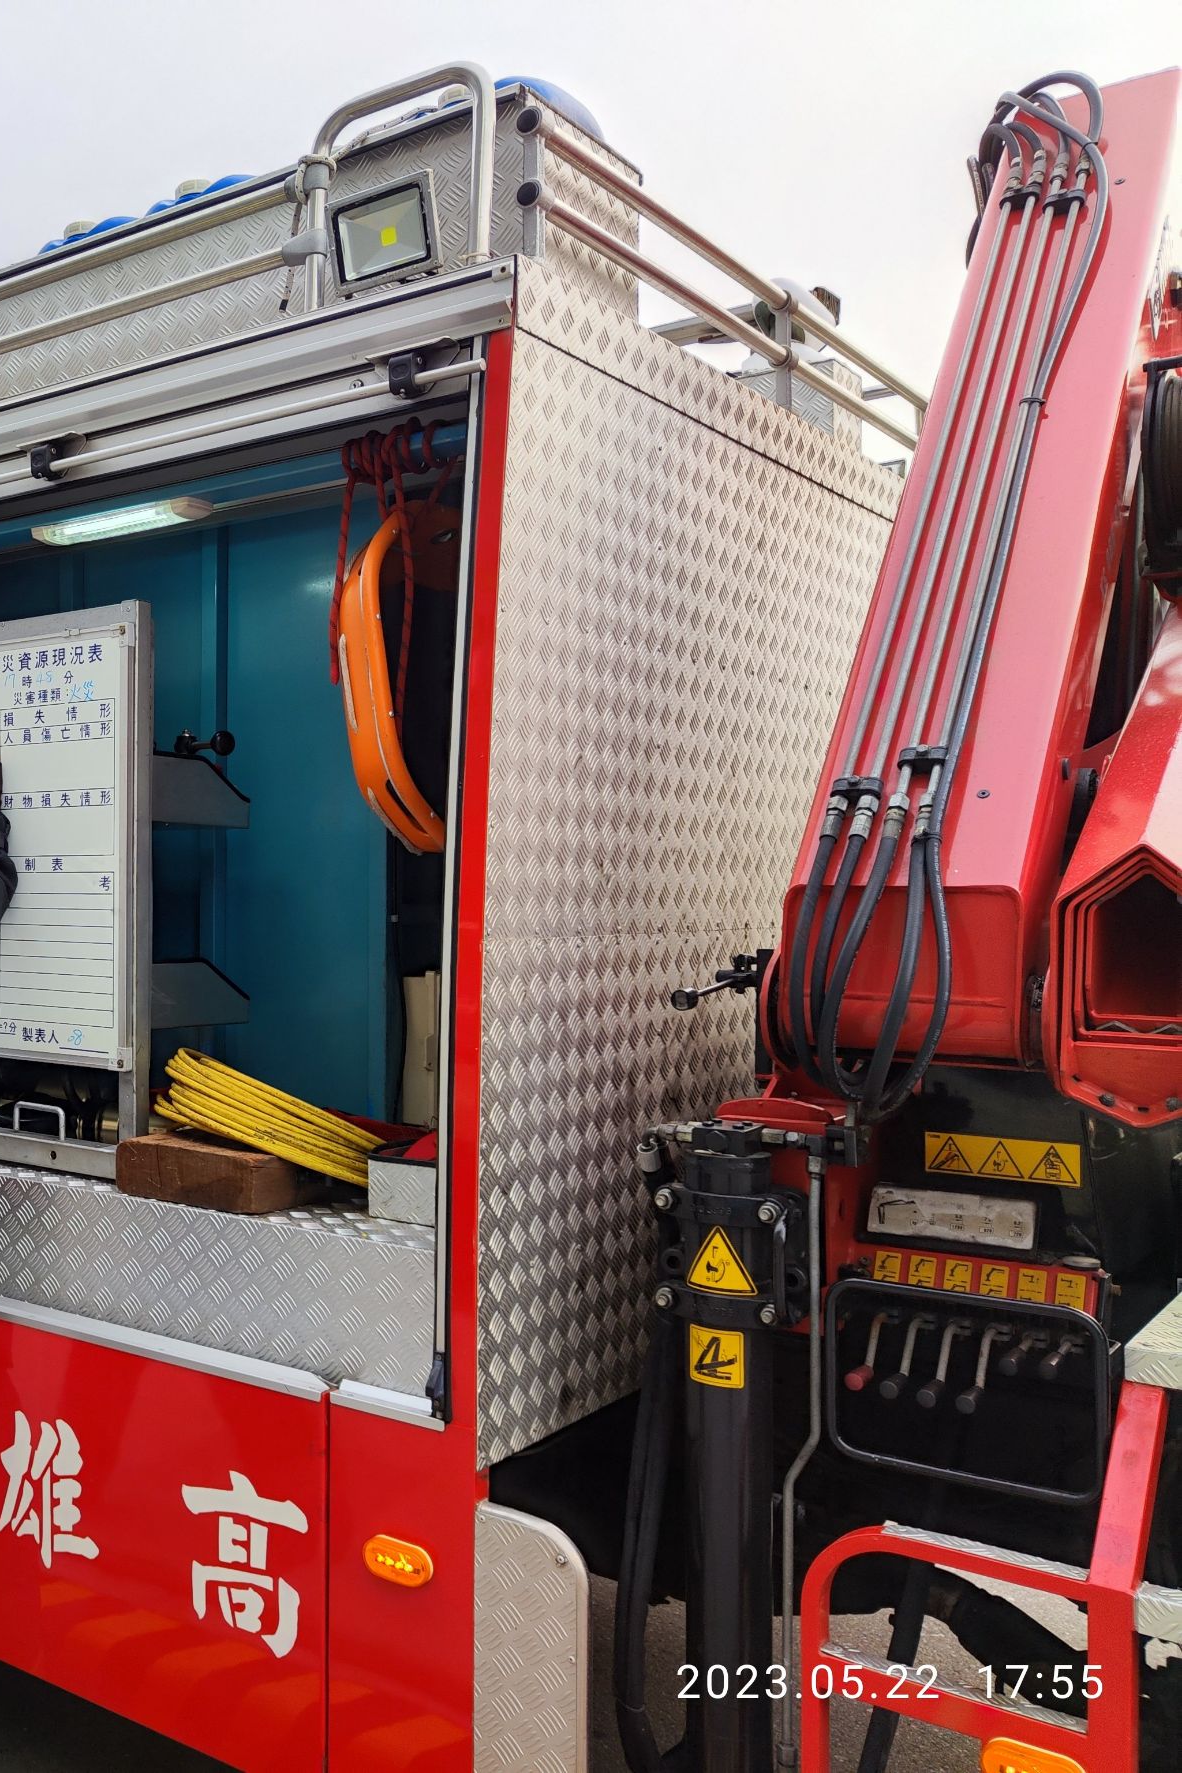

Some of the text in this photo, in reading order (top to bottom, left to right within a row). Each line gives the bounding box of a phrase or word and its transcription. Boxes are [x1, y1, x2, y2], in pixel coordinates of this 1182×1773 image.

[4, 673, 15, 688] 17
[21, 676, 32, 689] 時
[64, 670, 74, 684] 分
[4, 722, 111, 744] 人員傷亡情形
[4, 791, 111, 808] 財物損失情形
[25, 858, 63, 871] 制表
[99, 876, 111, 891] 考
[22, 1027, 59, 1044] 製表人
